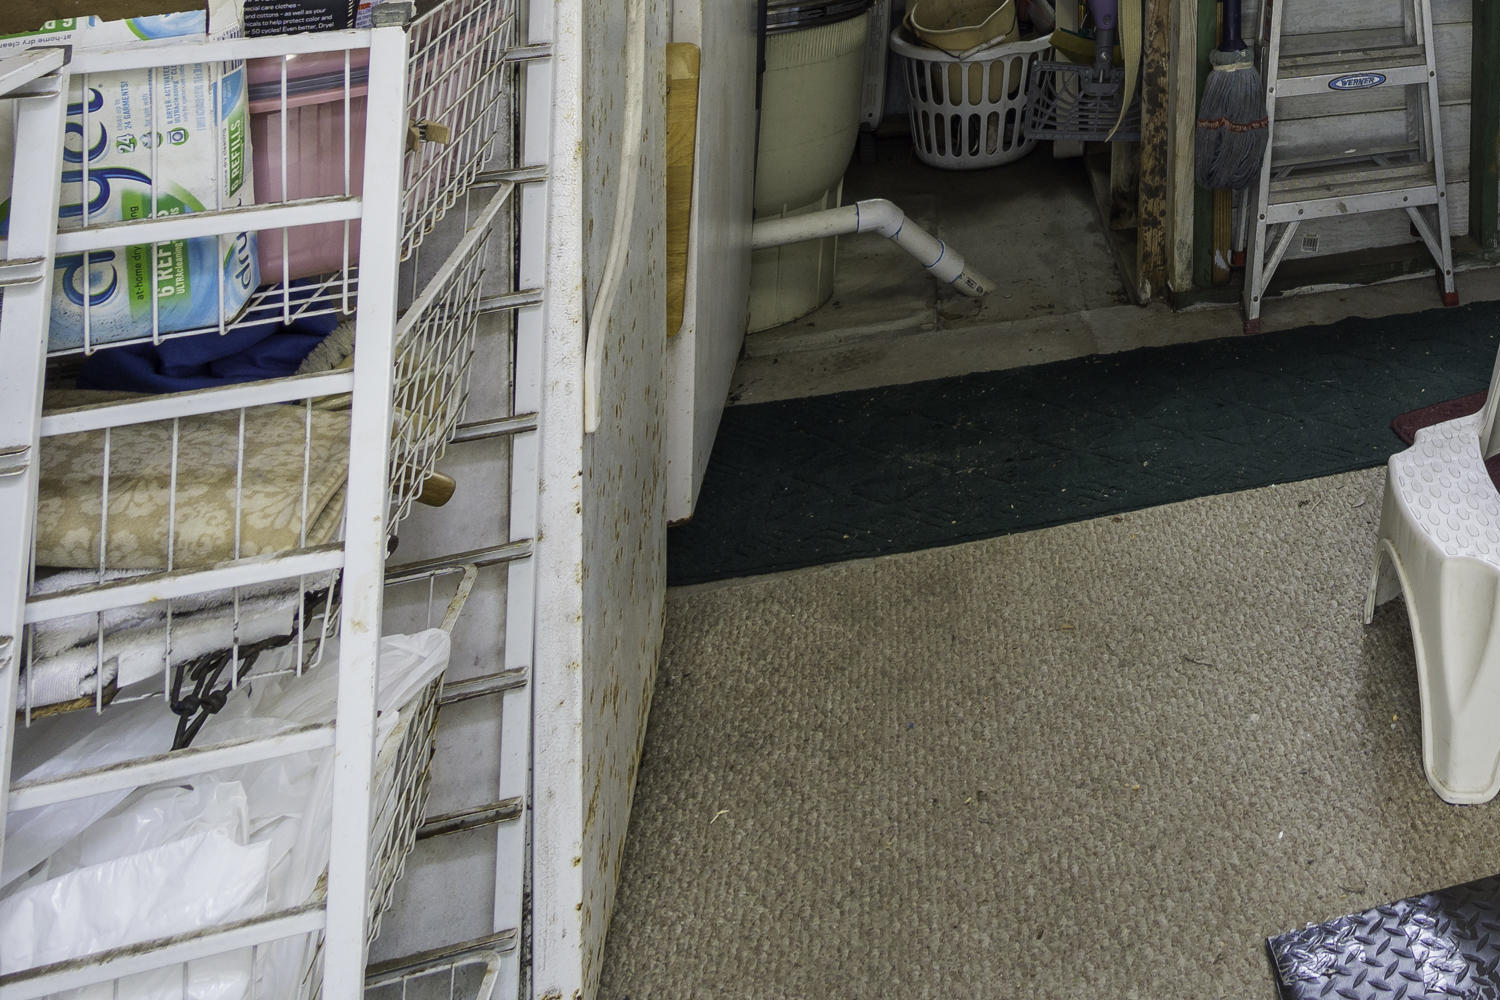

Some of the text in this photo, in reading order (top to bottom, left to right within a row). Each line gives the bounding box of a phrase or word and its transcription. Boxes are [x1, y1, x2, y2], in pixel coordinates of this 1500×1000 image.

[269, 18, 282, 27] help
[283, 17, 304, 25] protect
[305, 14, 320, 22] color
[321, 13, 333, 21] and
[318, 21, 334, 31] Dryel
[22, 38, 37, 46] dry
[38, 33, 72, 44] at-home
[1341, 76, 1375, 88] WERNER
[120, 80, 132, 130] 24 GARMENTS!
[116, 133, 136, 153] 24
[230, 119, 241, 177] REFILLS
[131, 245, 144, 300] at-home dry
